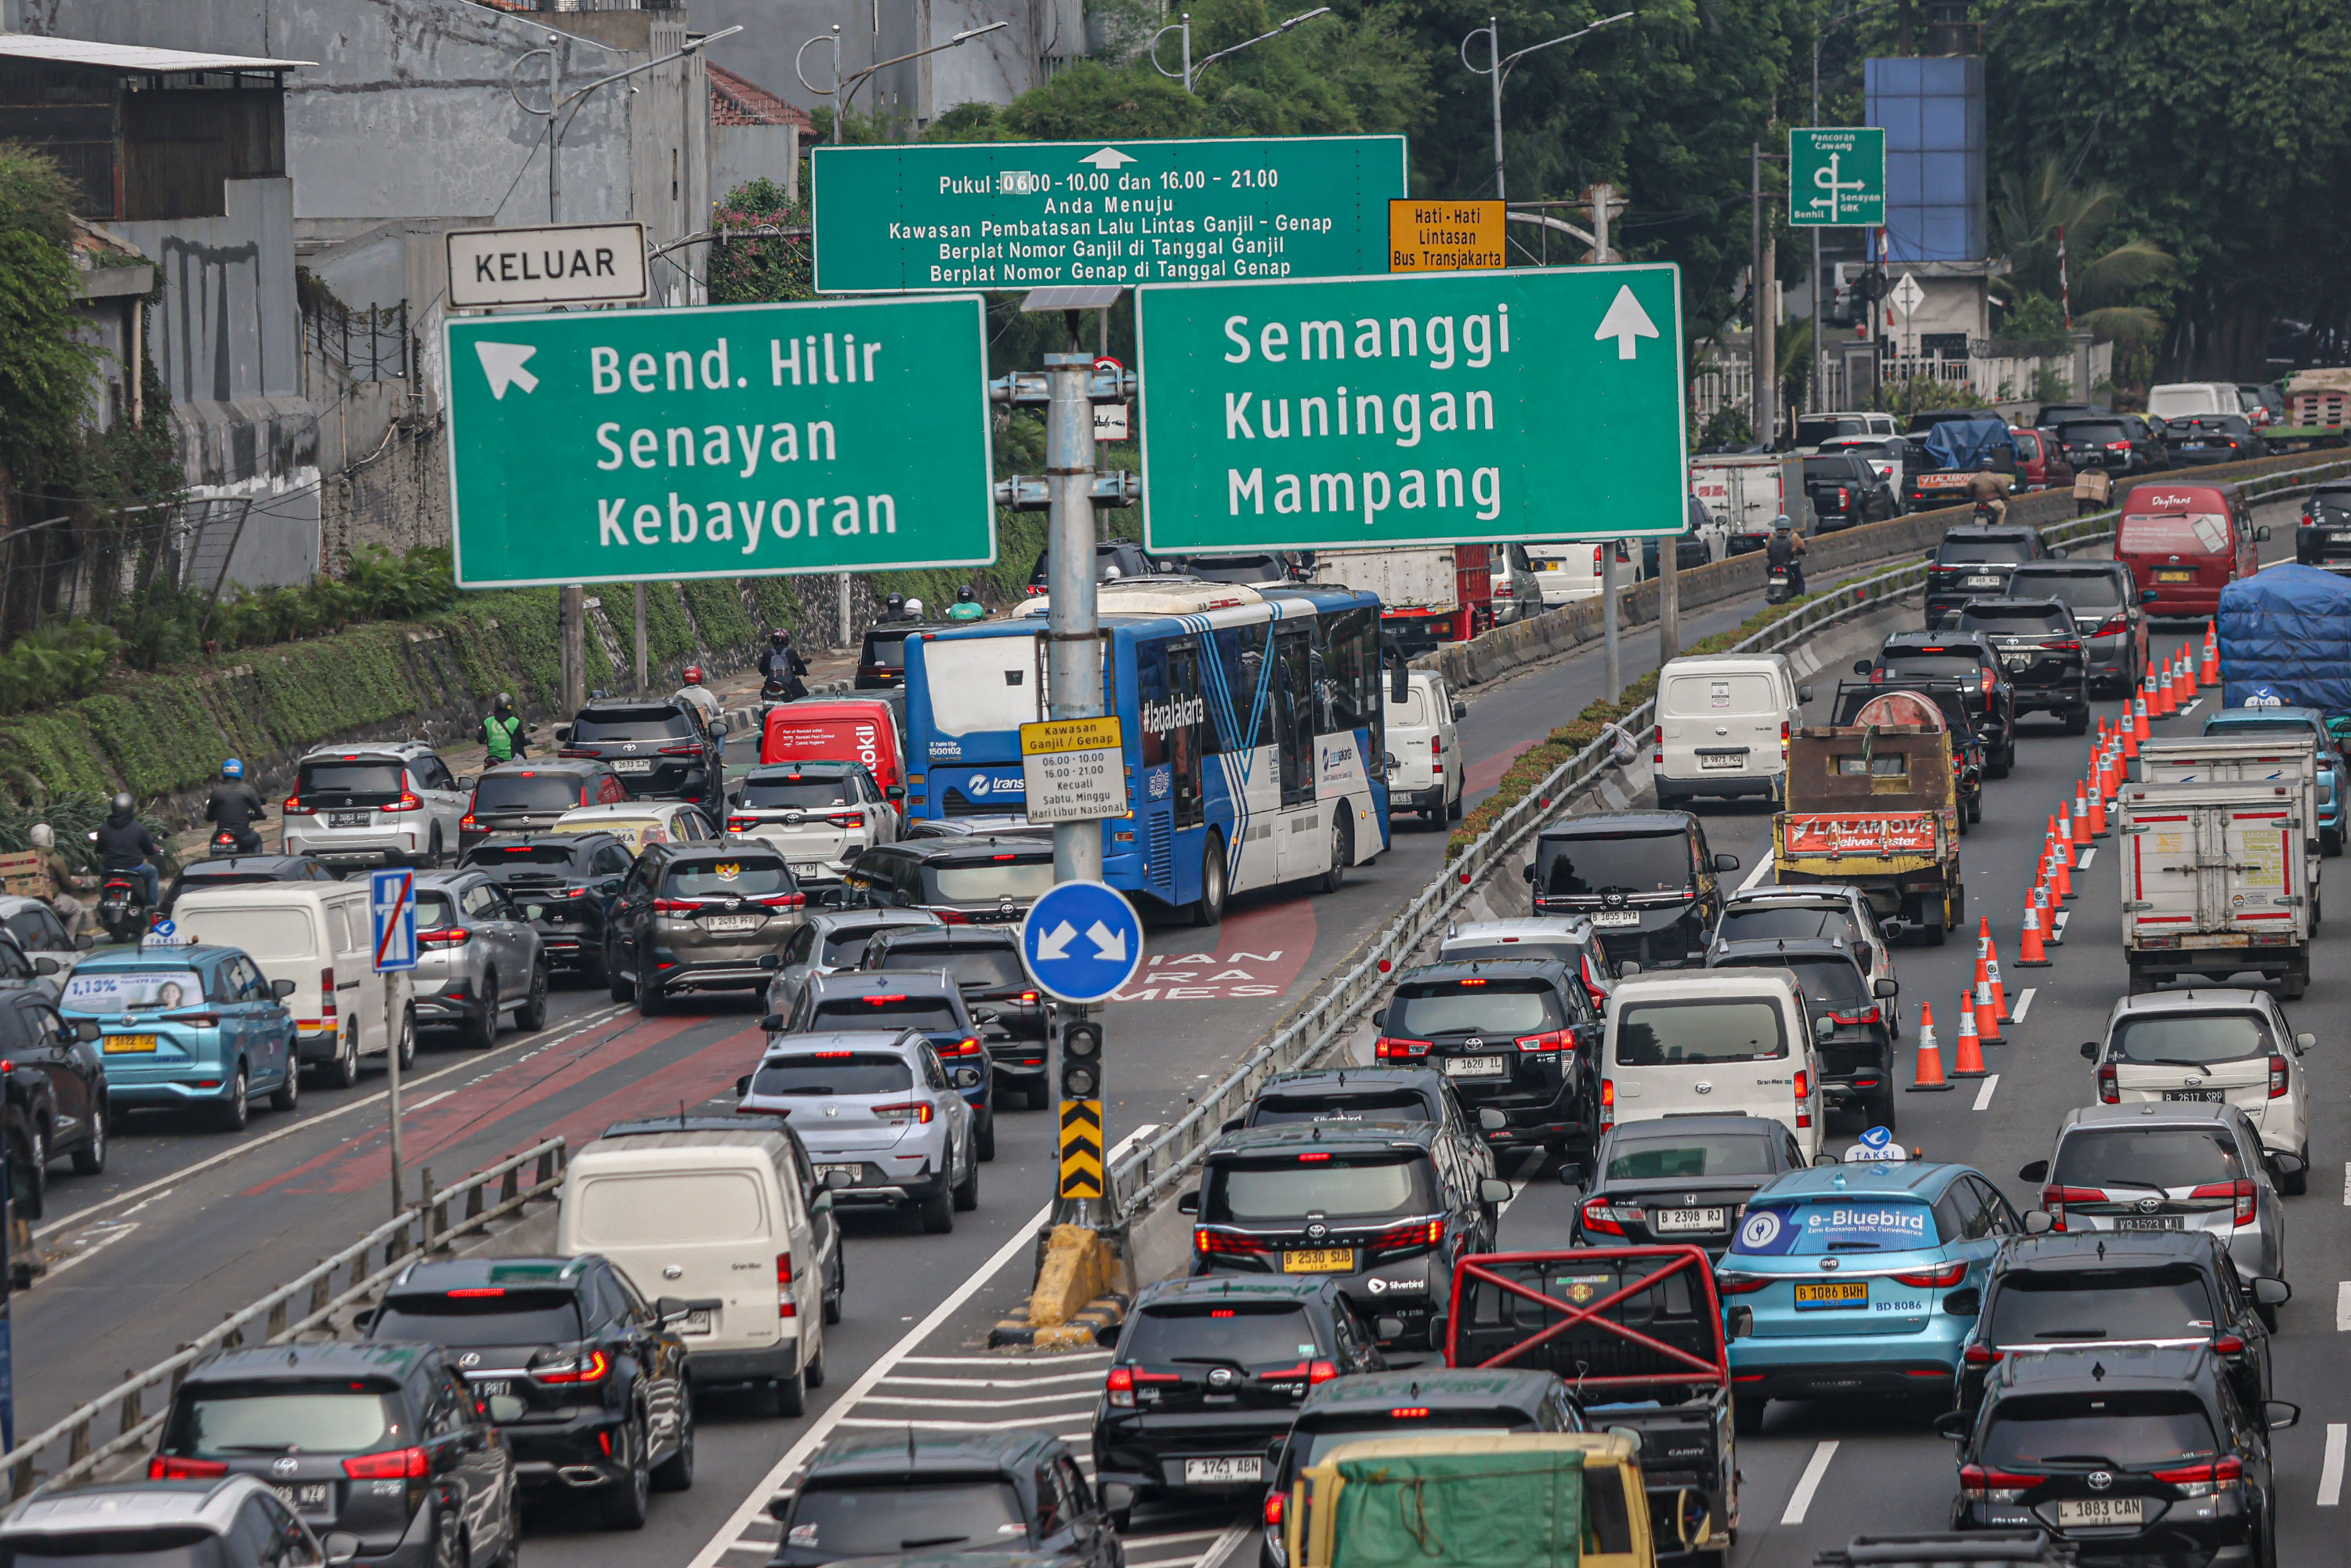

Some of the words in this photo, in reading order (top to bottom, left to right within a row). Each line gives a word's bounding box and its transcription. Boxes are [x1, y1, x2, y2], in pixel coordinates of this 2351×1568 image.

[1811, 133, 1856, 142] Pancoran
[1815, 142, 1853, 151] Cawang
[940, 176, 991, 194] Pukul
[1118, 172, 1150, 190] dan
[1160, 170, 1205, 190] 16.00
[1231, 168, 1278, 188] 21.00
[1044, 197, 1093, 214] Anda
[1104, 197, 1173, 215] Menuju
[1840, 194, 1881, 203] Senayan
[1415, 208, 1442, 225] Hati
[1454, 207, 1480, 224] Hati
[1794, 210, 1824, 219] Benhil
[889, 223, 971, 239] Kawasan
[981, 219, 1091, 237] Pembatasan
[1098, 217, 1134, 235] Lalu
[1142, 215, 1196, 234] Lintas
[1204, 215, 1253, 235] Ganjil
[1275, 214, 1332, 234] Genap
[1419, 228, 1476, 245] Lintasan
[940, 242, 1003, 262] Berplat
[1009, 241, 1066, 259] Nomor
[1073, 240, 1122, 259] Ganjil
[1129, 240, 1145, 256] di
[1151, 238, 1223, 260] Tanggal
[1232, 237, 1284, 257] Ganjil
[475, 248, 616, 283] KELUAR
[1393, 250, 1415, 267] Bus
[1423, 249, 1502, 270] Transjakarta
[930, 264, 995, 284] Berplat
[1004, 263, 1062, 281] Nomor
[1071, 263, 1127, 281] Genap
[1135, 262, 1150, 277] di
[1159, 259, 1226, 281] Tanggal
[1233, 259, 1291, 279] Genap
[1224, 303, 1510, 371] Semanggi
[591, 337, 748, 394] Bend.
[770, 332, 881, 386] Hilir
[1226, 384, 1495, 448] Kuningan
[596, 420, 836, 478] Senayan
[1229, 465, 1502, 523] Mampang
[2152, 494, 2192, 508] DayTrans
[598, 492, 897, 555] Kebayoran
[1143, 693, 1204, 741] #JagaJakarta
[1045, 724, 1097, 736] Kawasan
[1030, 739, 1063, 750] Ganjil
[1067, 737, 1073, 747] /
[1077, 734, 1114, 745] Genap
[929, 747, 962, 755] 1500102
[1043, 755, 1070, 766] 06.00
[1079, 752, 1104, 763] 10.00
[1045, 767, 1070, 778] 16.00
[1078, 766, 1103, 776] 21.00
[1057, 778, 1093, 791] Kecuali
[1043, 795, 1074, 806] Sabtu,
[1076, 791, 1110, 802] Minggu
[1031, 807, 1052, 820] Hari
[1053, 806, 1078, 817] Libur
[1080, 802, 1124, 815] Nasional
[1813, 819, 1933, 835] LALAMOVE
[1592, 913, 1597, 922] B
[1601, 912, 1620, 921] 1855
[1623, 911, 1637, 920] DYA
[72, 980, 117, 996] 1,13%
[1447, 1060, 1452, 1070] F
[1462, 1059, 1483, 1069] 1620
[1490, 1059, 1500, 1068] IL
[2206, 1092, 2223, 1103] SRP
[1855, 1150, 1895, 1161] TAKSI
[1661, 1212, 1668, 1223] B
[1675, 1211, 1700, 1222] 2398
[1708, 1209, 1720, 1221] RJ
[1809, 1209, 1924, 1230] e-Bluebird
[1285, 1254, 1292, 1265] B
[1299, 1251, 1325, 1264] 2530
[1331, 1248, 1351, 1262] SUB
[1389, 1280, 1424, 1290] Silverbird
[1799, 1287, 1806, 1299] B
[1810, 1285, 1838, 1298] 1086
[1842, 1284, 1864, 1298] BWH
[1875, 1302, 1892, 1311] BD
[1894, 1301, 1922, 1310] 8086
[1272, 1382, 1304, 1391] AYLA
[1187, 1462, 1194, 1475] F
[1237, 1459, 1259, 1473] ABN
[2060, 1505, 2068, 1517] L
[2077, 1501, 2109, 1515] 1883
[2115, 1499, 2141, 1515] CAN
